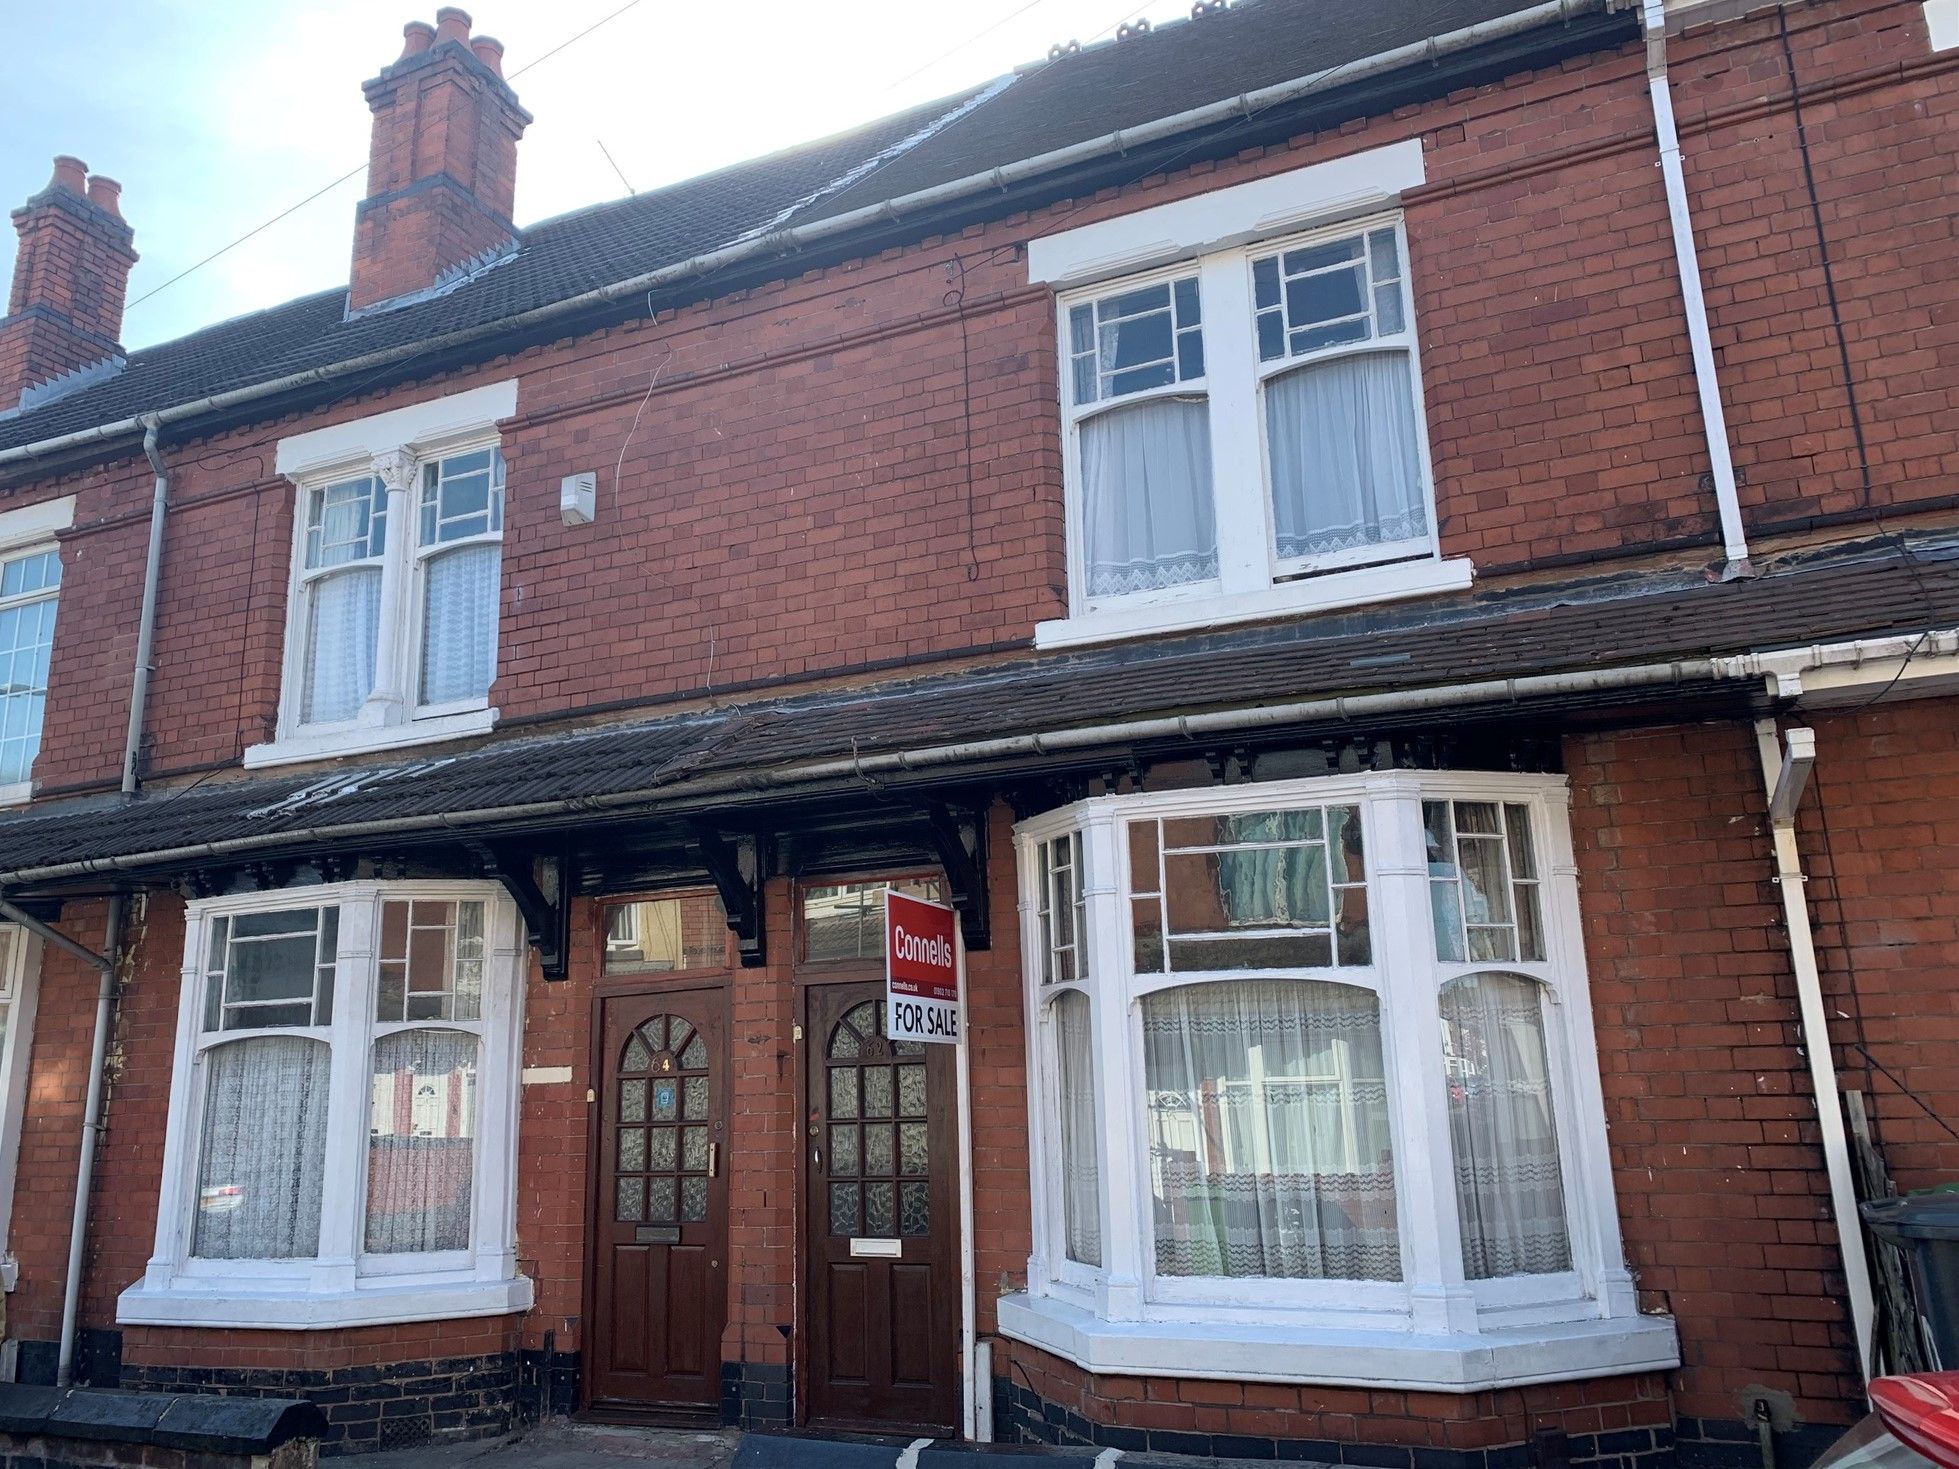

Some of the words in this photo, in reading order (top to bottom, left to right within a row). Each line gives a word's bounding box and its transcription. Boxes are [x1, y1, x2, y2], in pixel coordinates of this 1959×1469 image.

[895, 925, 952, 968] Connells
[895, 1002, 923, 1034] FOR
[927, 1006, 957, 1037] SALE
[651, 1056, 670, 1072] 64
